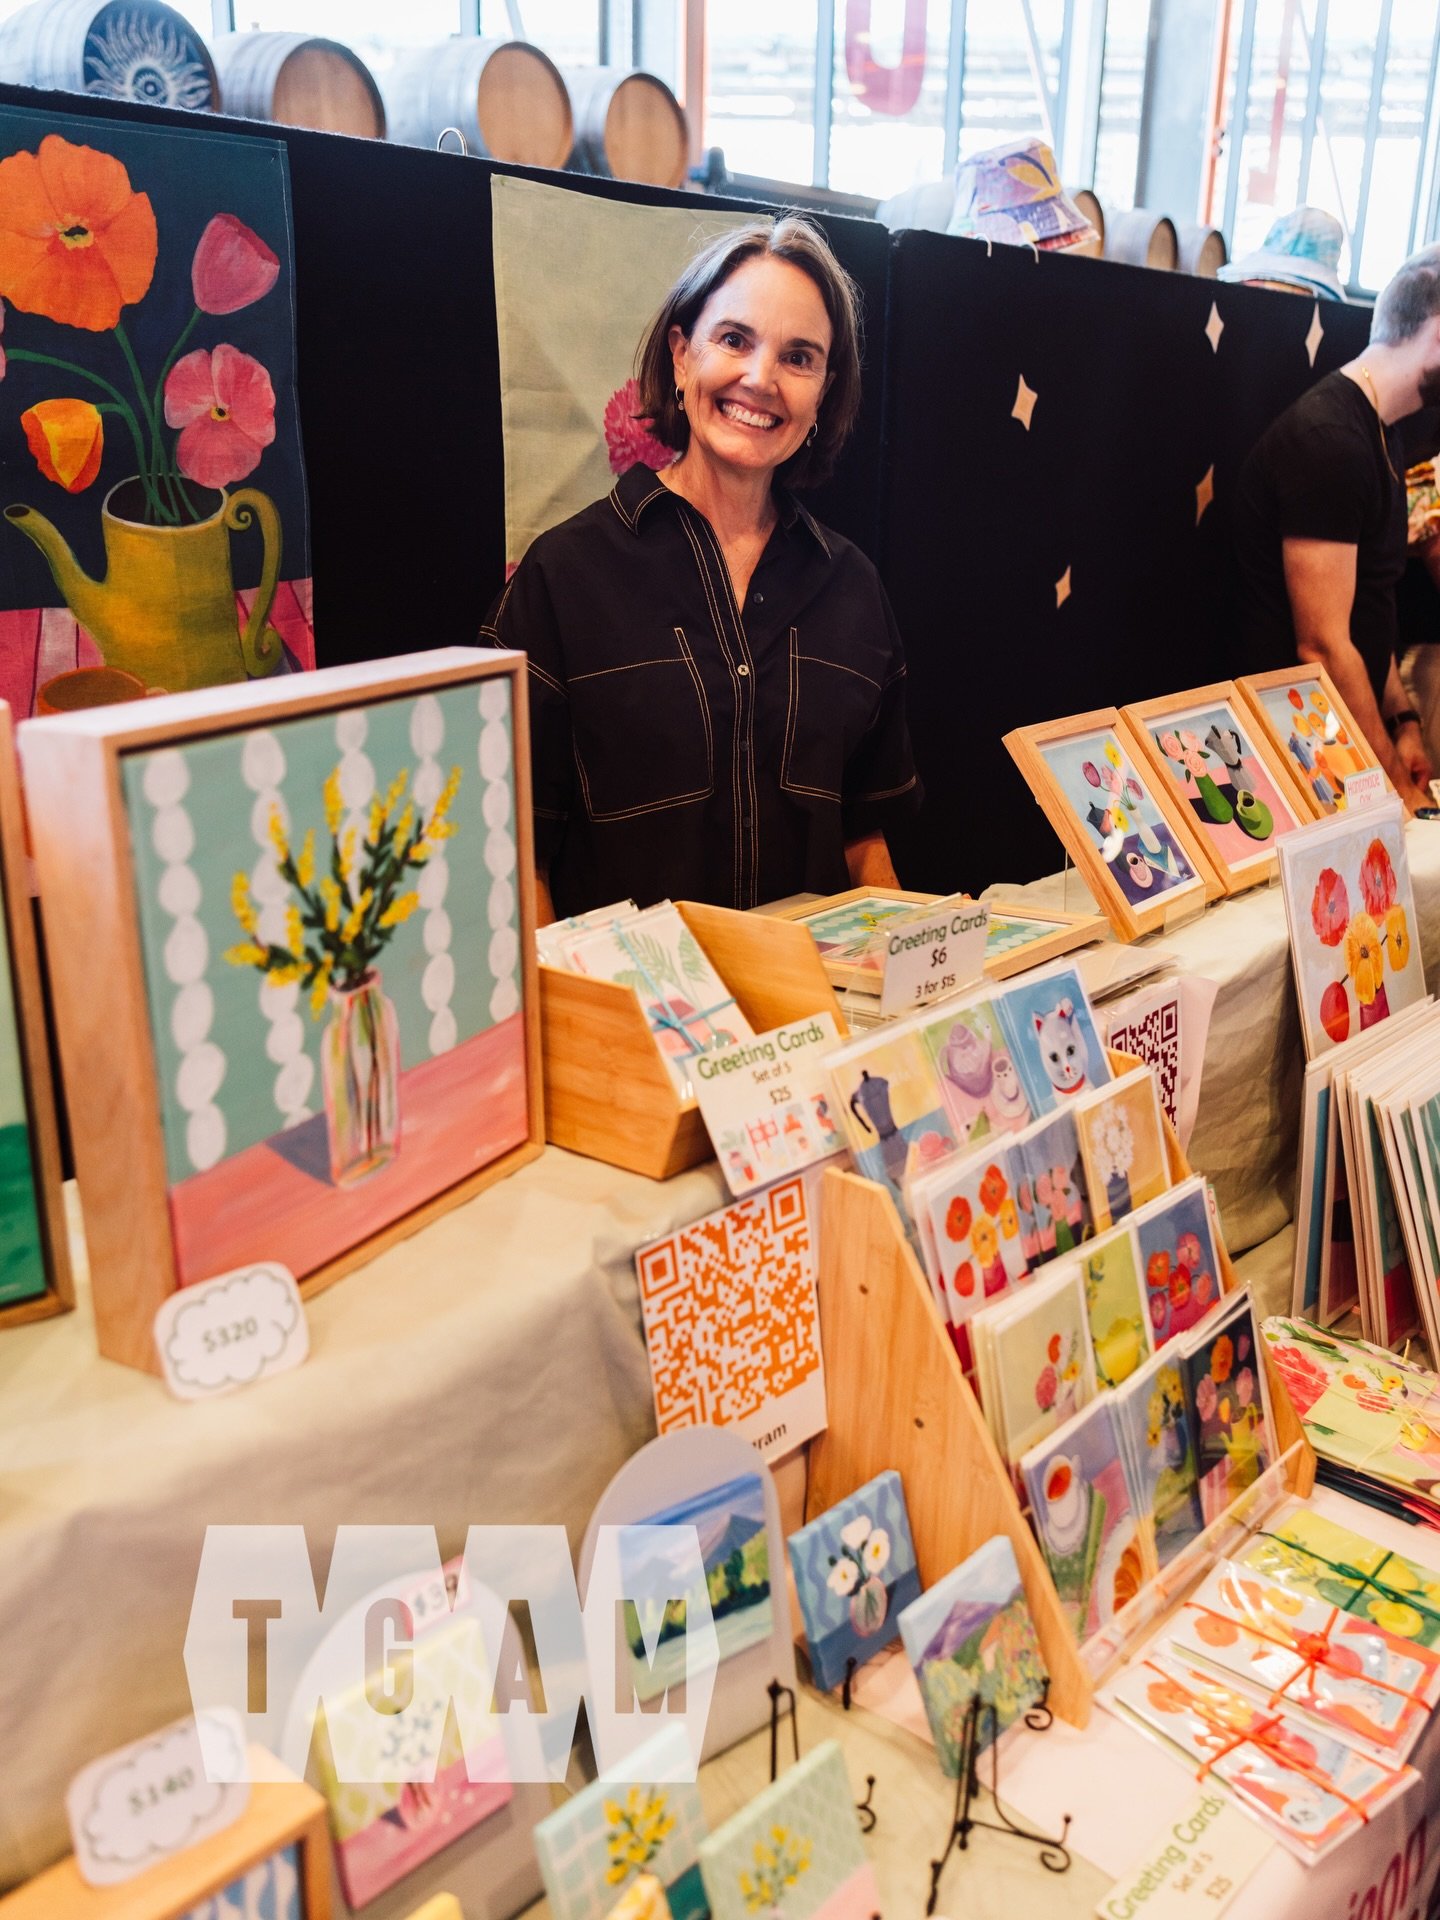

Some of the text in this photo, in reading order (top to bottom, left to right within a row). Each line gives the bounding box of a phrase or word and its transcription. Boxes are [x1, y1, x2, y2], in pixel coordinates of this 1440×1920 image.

[888, 909, 988, 956] Greeting Cards
[930, 946, 948, 968] $6
[915, 984, 922, 999] 3
[924, 979, 939, 995] for
[697, 1020, 825, 1080] Greeting Cards
[752, 1068, 771, 1084] Set
[769, 1086, 792, 1105] $25
[202, 1317, 258, 1354] $320
[752, 1423, 787, 1451] ram
[1106, 1795, 1226, 1920] Greeting Cards
